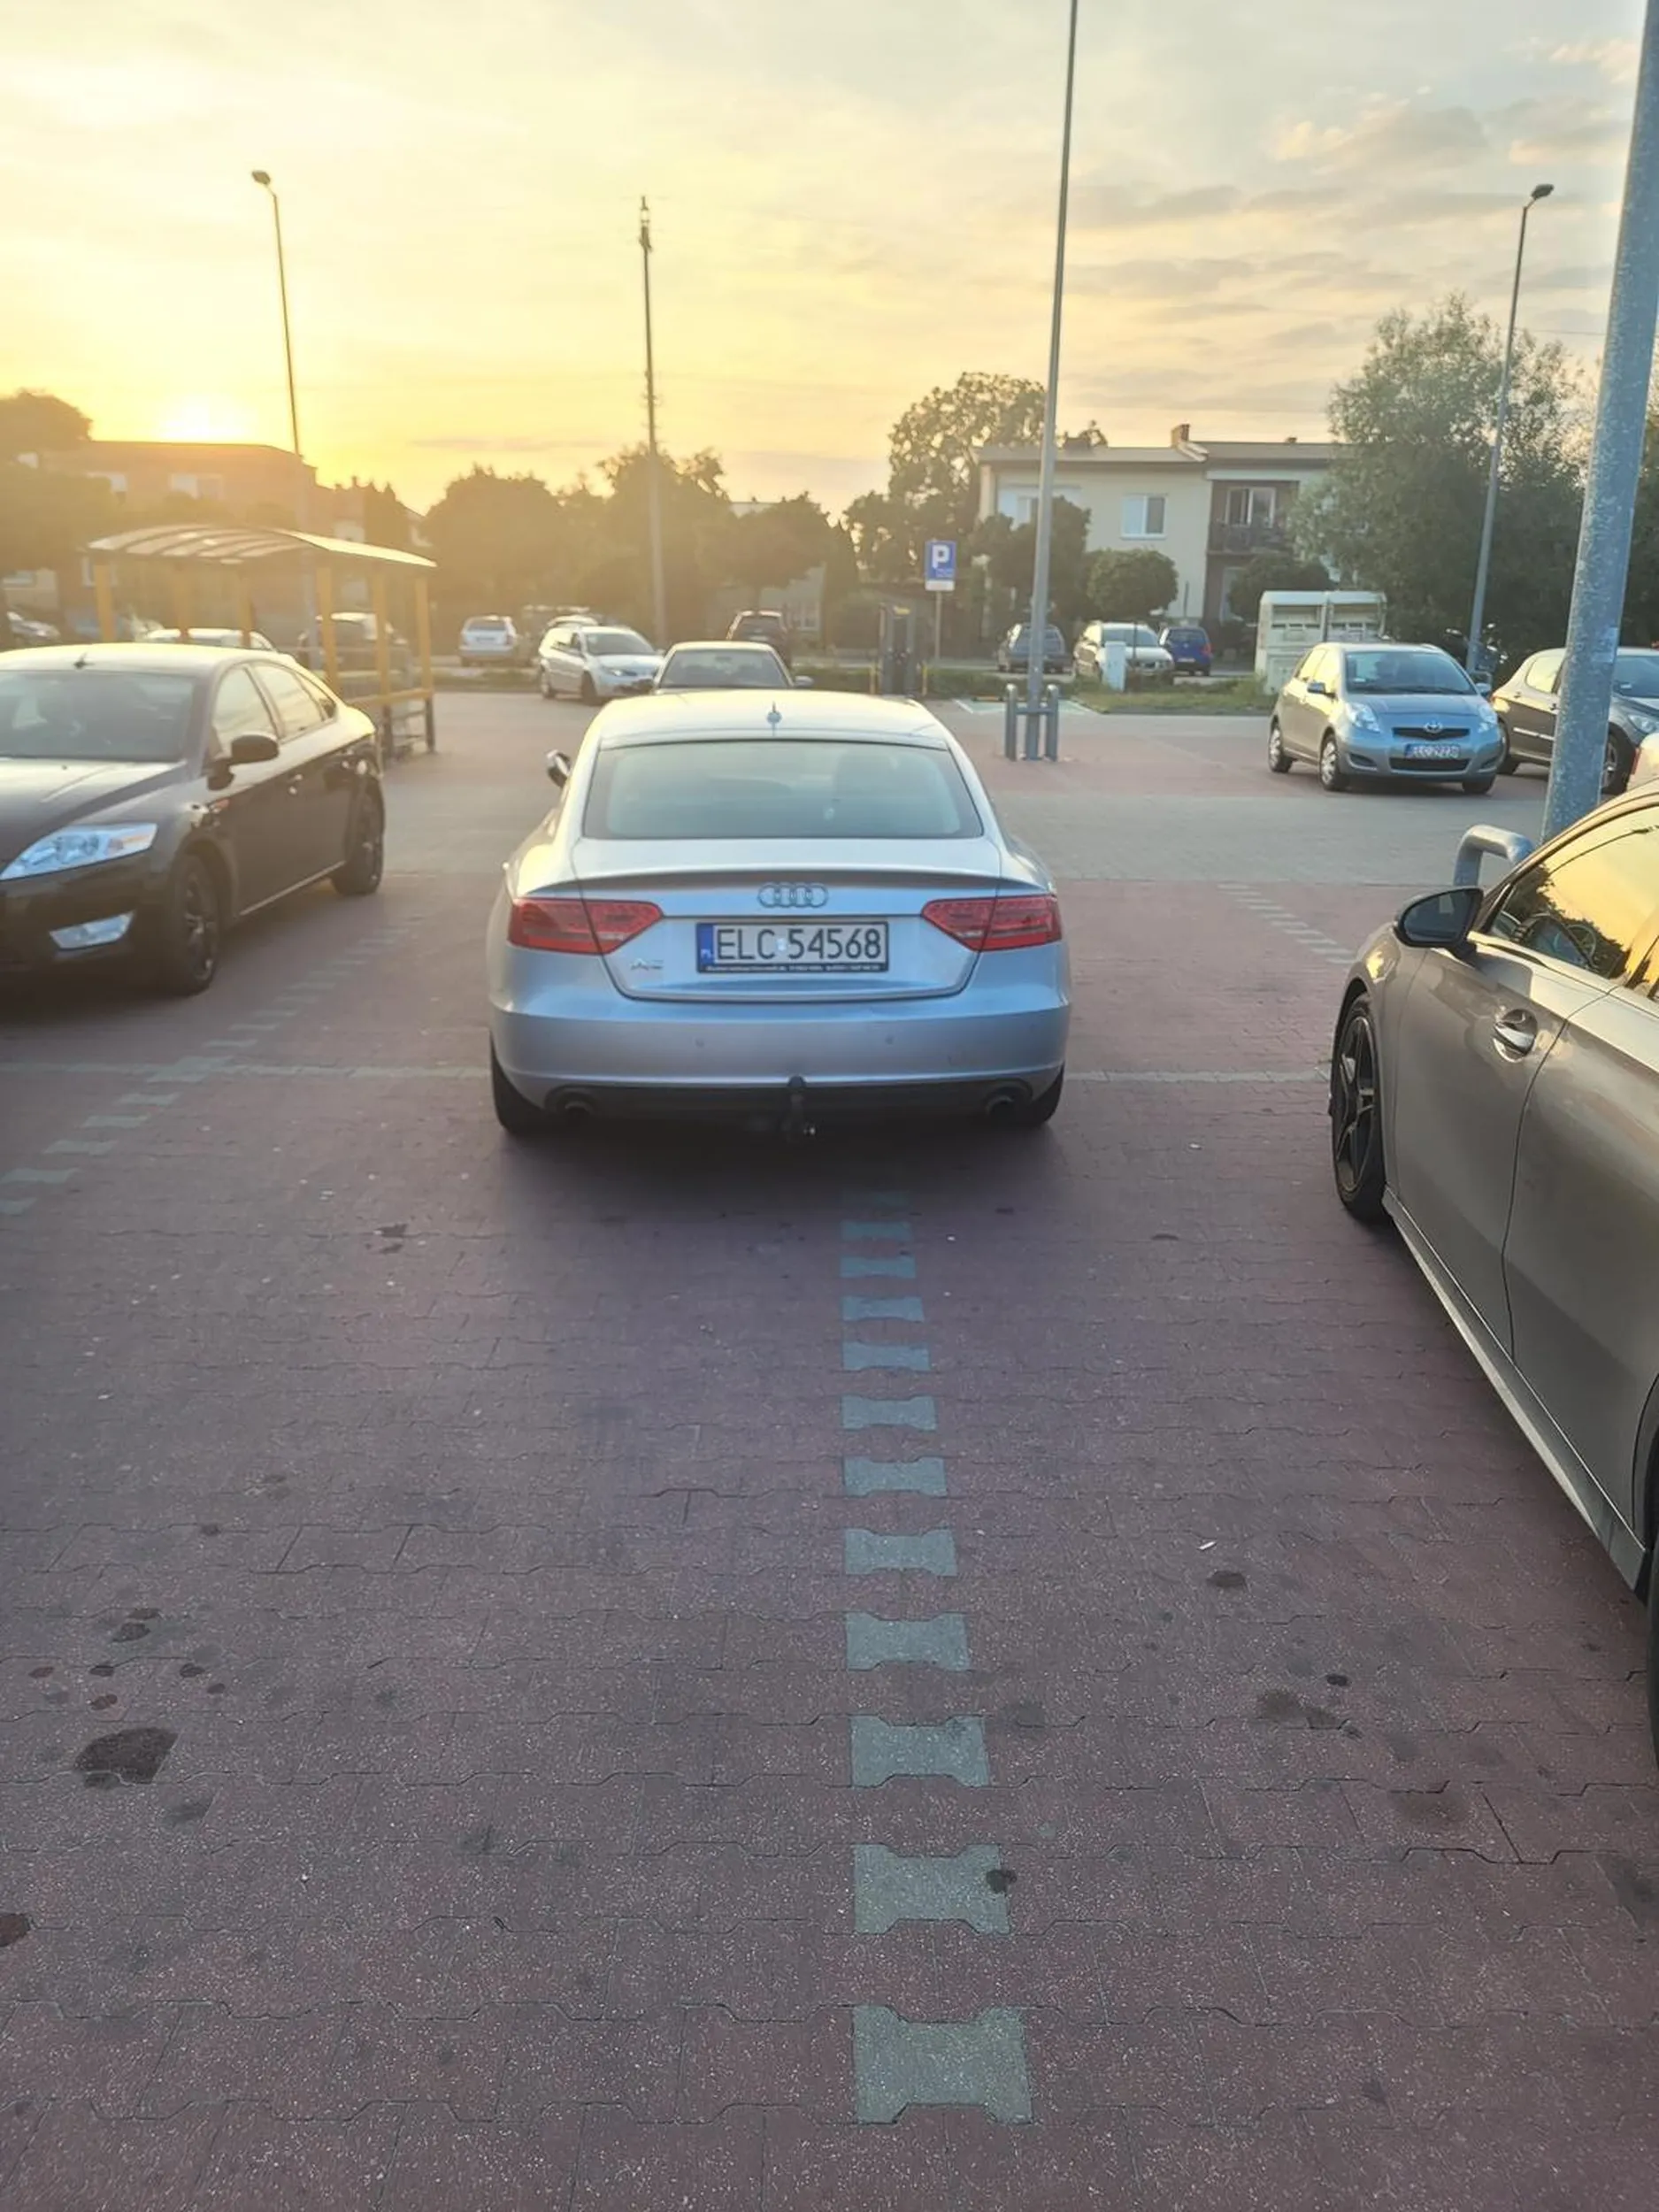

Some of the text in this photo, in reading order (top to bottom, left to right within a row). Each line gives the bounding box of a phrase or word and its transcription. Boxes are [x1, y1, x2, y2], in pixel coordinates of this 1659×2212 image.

[932, 544, 950, 569] P
[718, 928, 881, 960] ELC 54568
